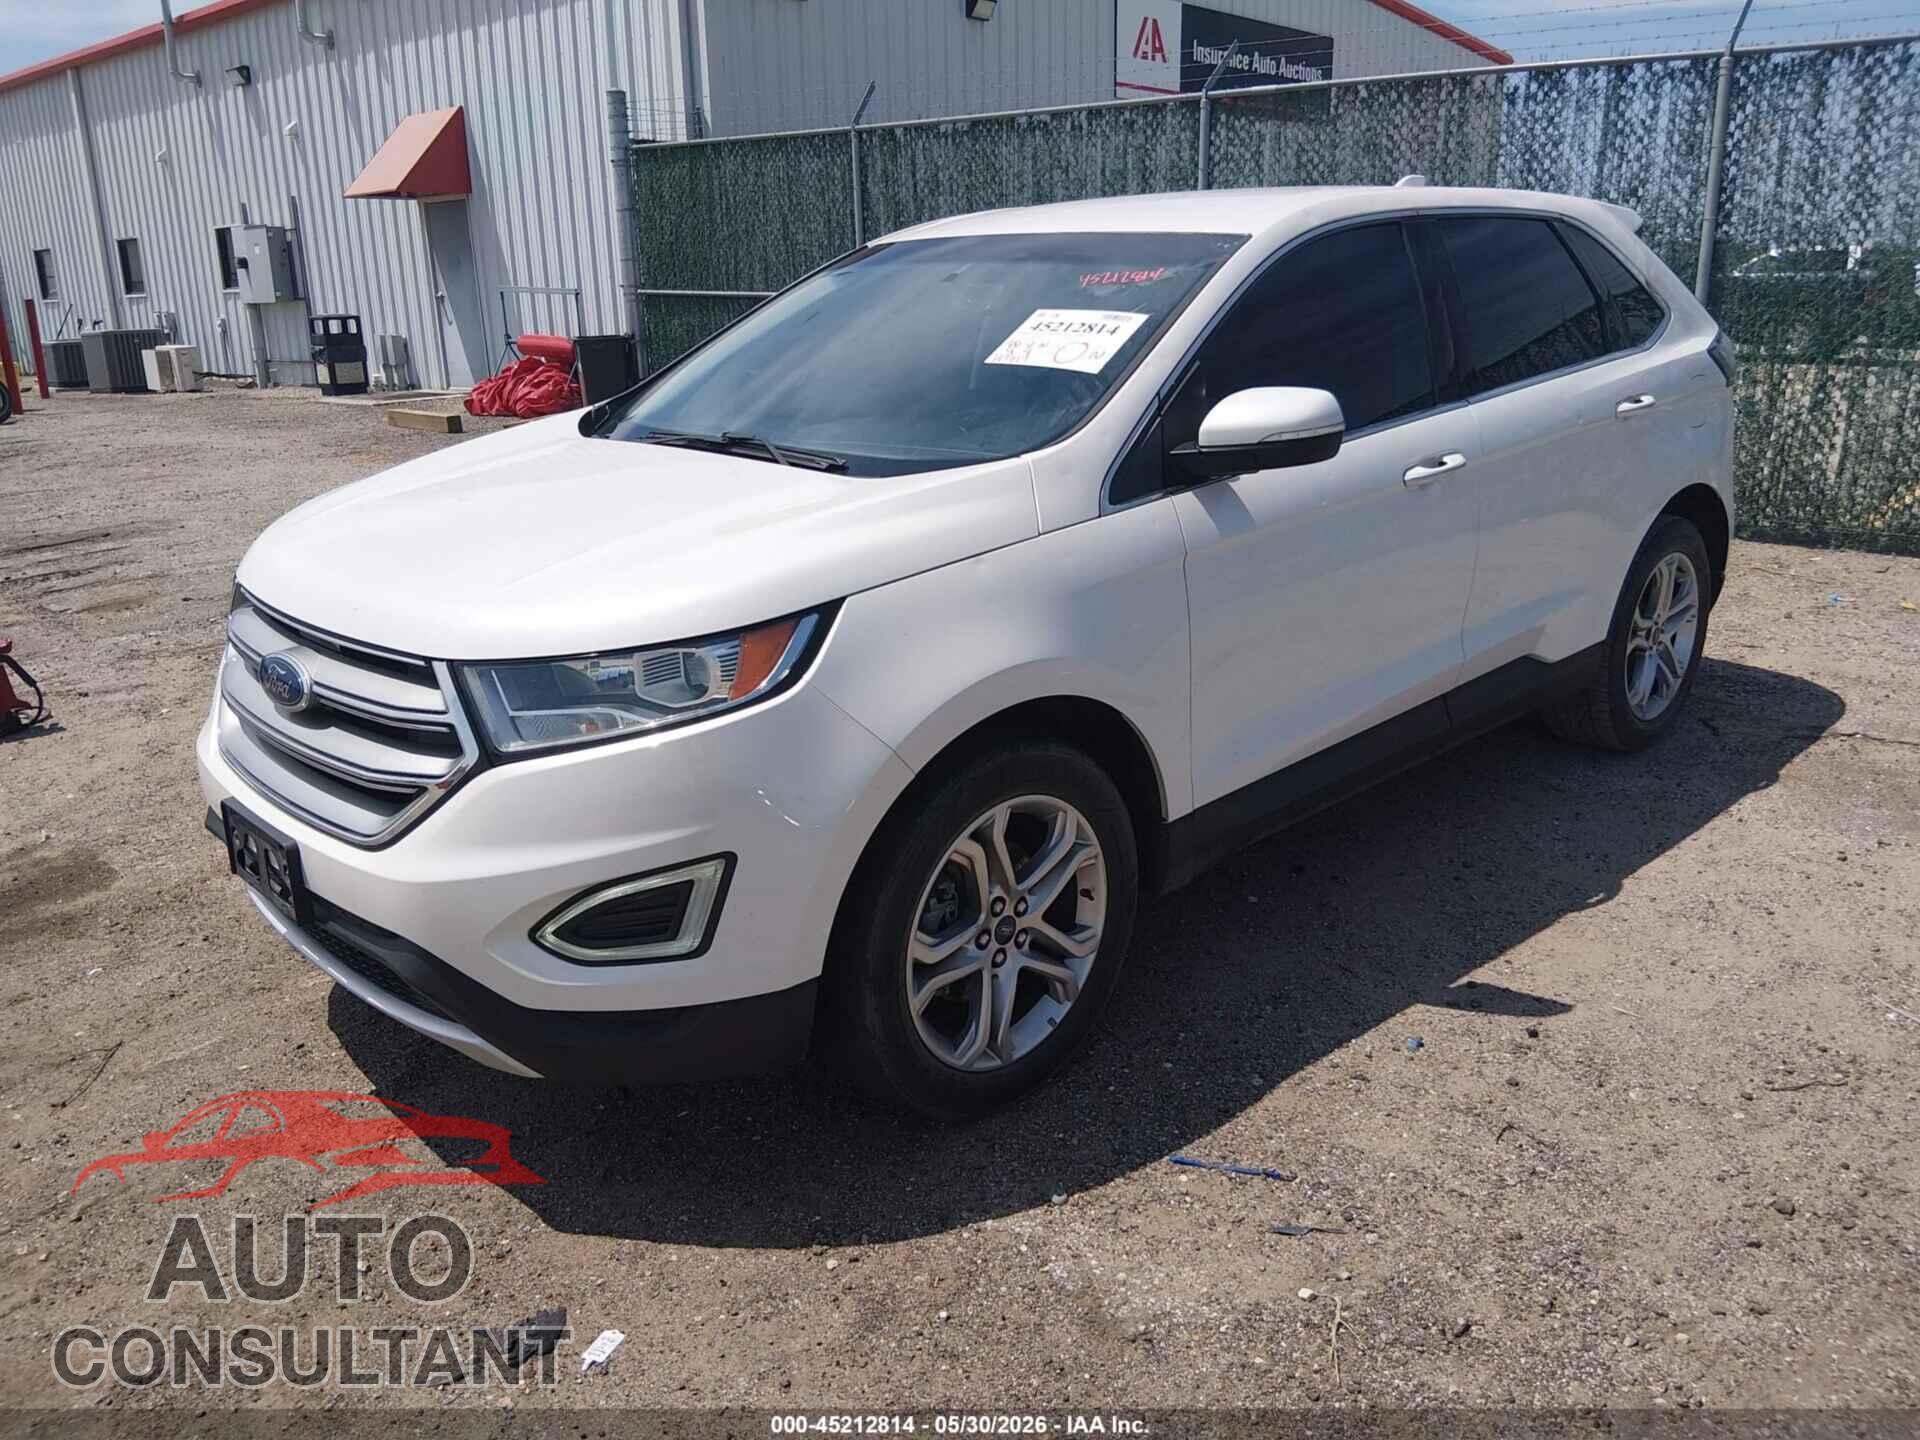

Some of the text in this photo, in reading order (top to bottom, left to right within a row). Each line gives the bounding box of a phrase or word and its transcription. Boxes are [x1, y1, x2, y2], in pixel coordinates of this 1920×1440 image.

[1193, 39, 1322, 81] Insurnce Auto Auctions
[1030, 321, 1121, 335] 45212814
[263, 664, 292, 698] Ford
